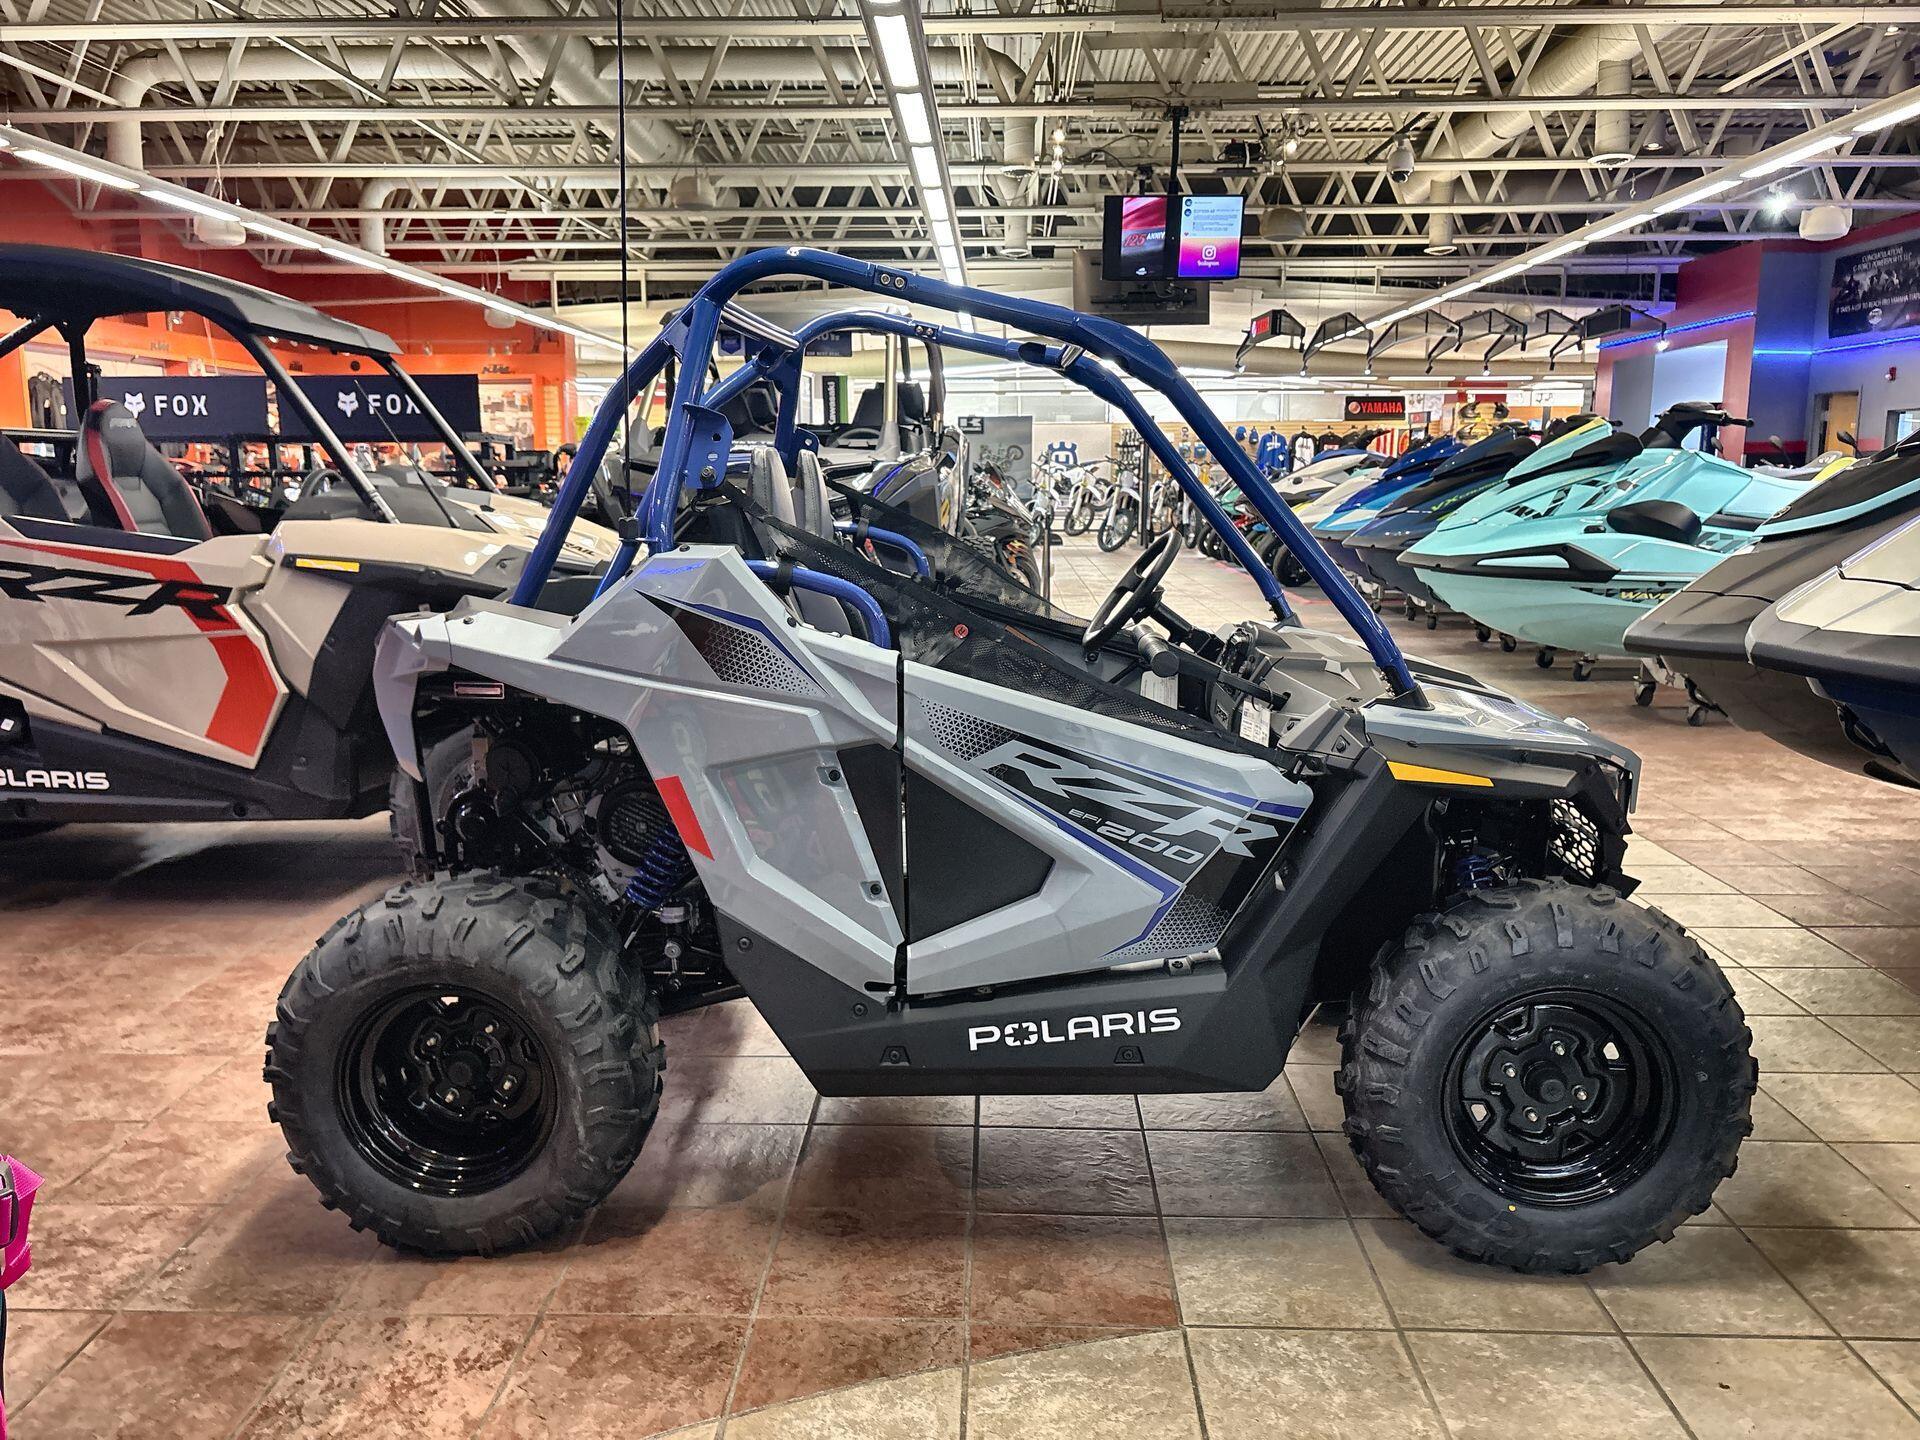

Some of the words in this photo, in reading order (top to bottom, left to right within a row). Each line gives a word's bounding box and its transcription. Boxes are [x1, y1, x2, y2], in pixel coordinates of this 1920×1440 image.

[1123, 232, 1147, 248] 125
[154, 394, 208, 416] FOX
[368, 394, 422, 415] FOX
[827, 381, 836, 426] Kawasaki
[1361, 401, 1403, 414] YAMAHA
[972, 739, 1279, 858] RZR
[1068, 808, 1102, 825] EFI
[1096, 821, 1205, 865] 200
[967, 1007, 1182, 1051] POLARIS
